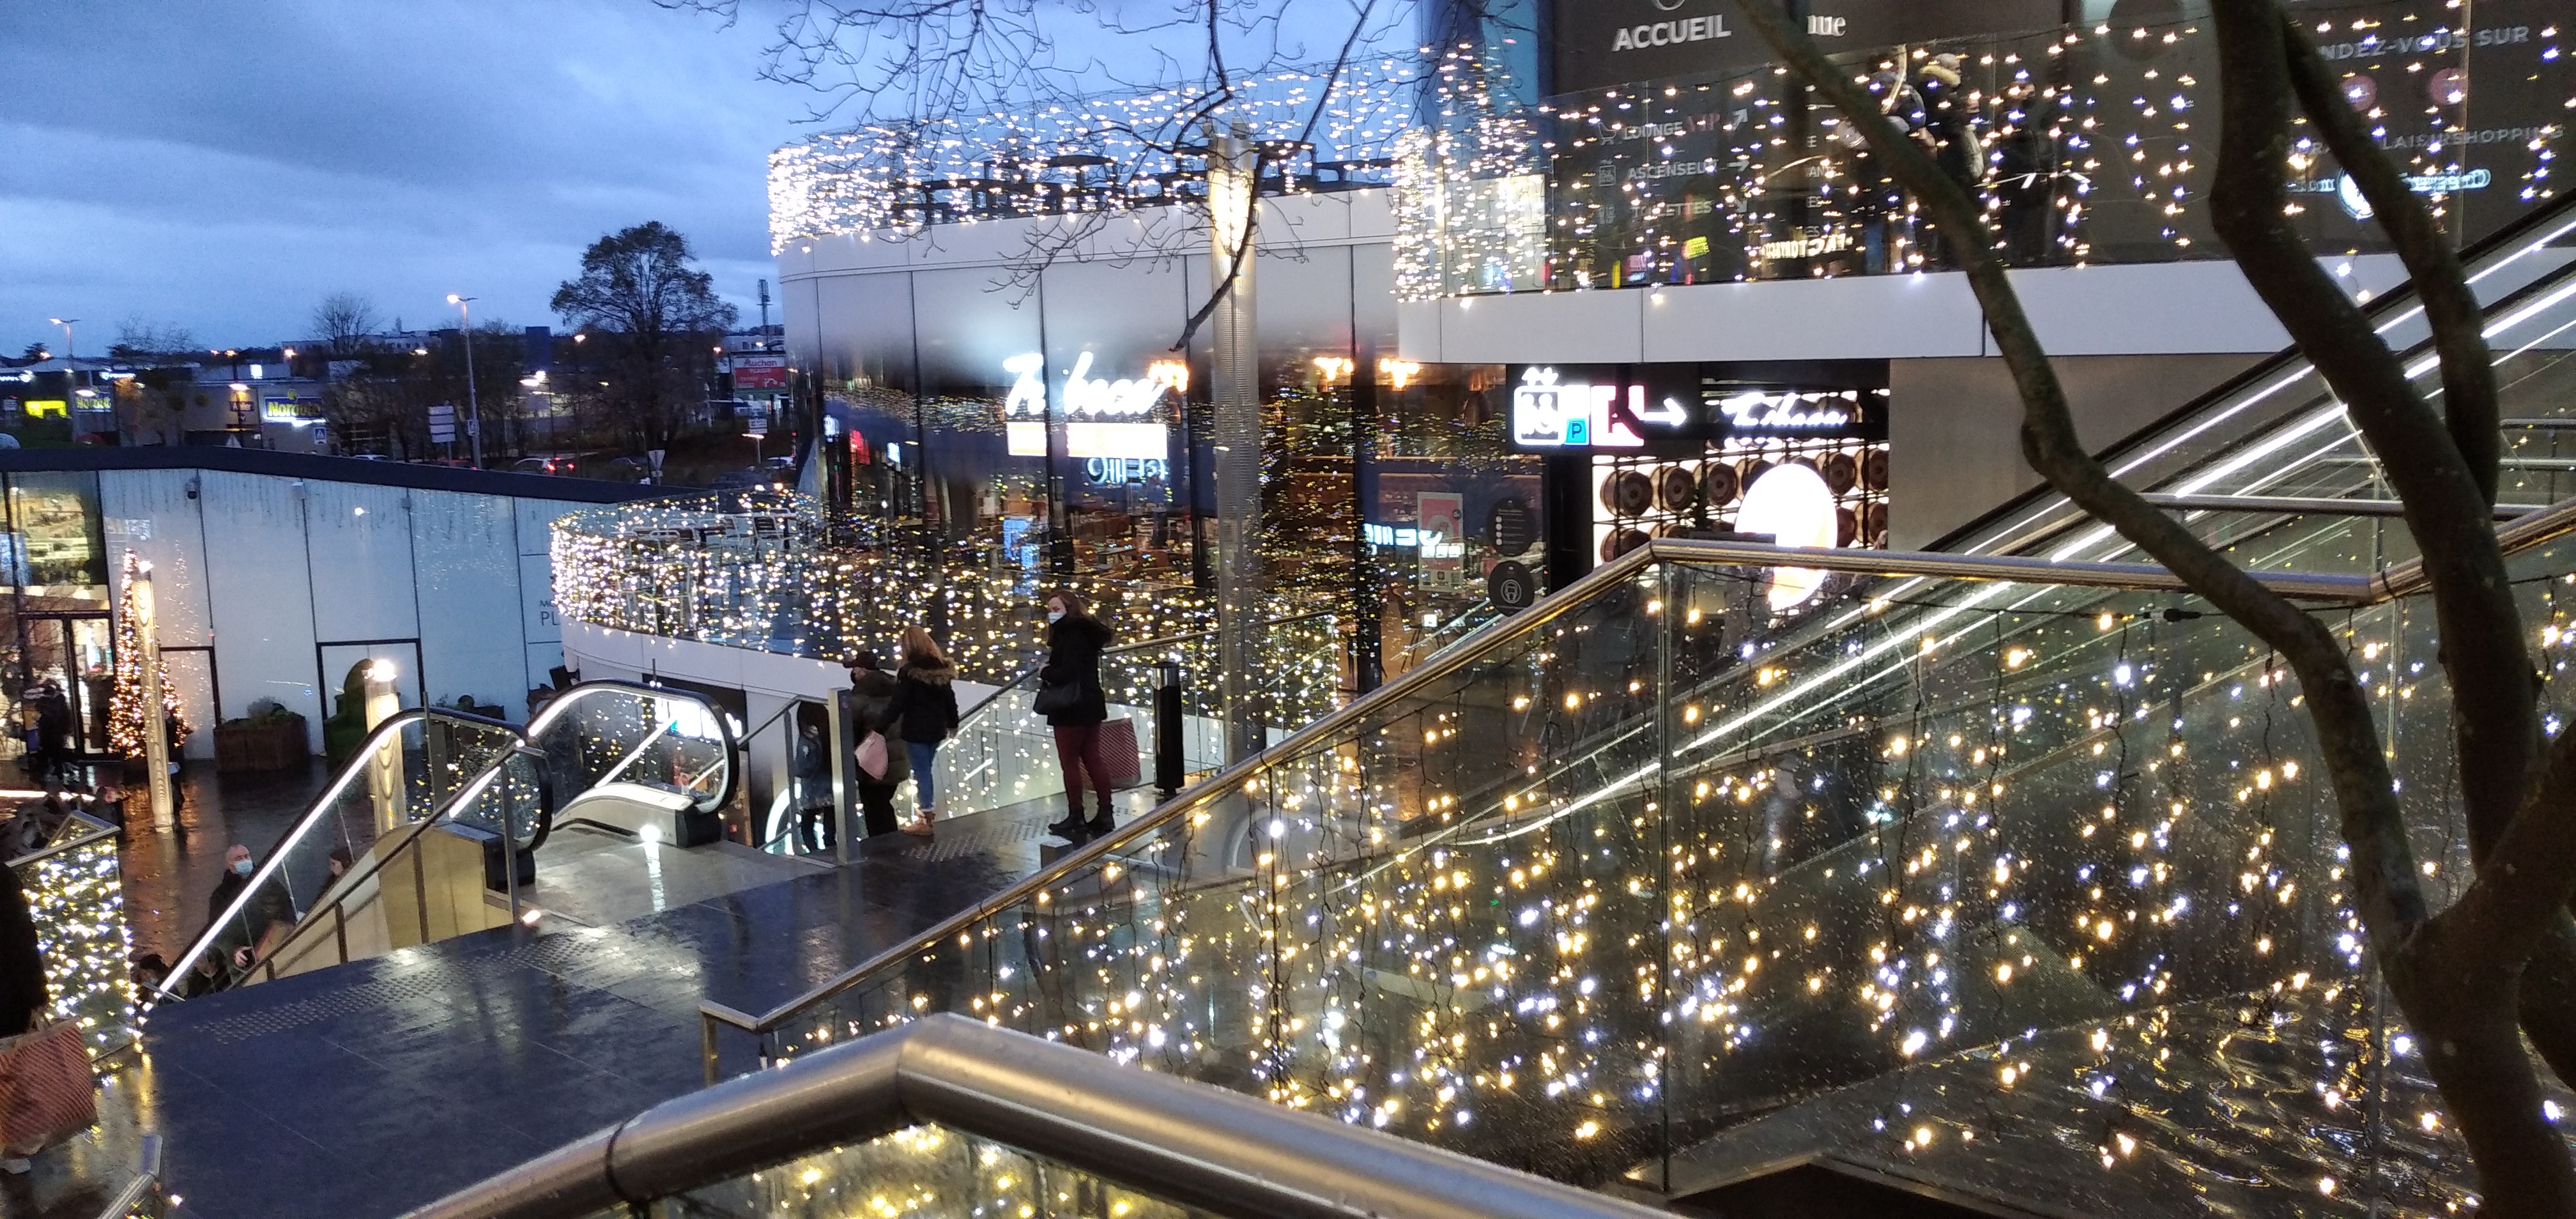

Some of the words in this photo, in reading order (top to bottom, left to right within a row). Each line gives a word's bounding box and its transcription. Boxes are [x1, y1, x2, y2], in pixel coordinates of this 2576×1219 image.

[1611, 14, 1732, 52] ACCUEIL
[2318, 27, 2467, 60] NDEZ-VOUS
[2474, 26, 2529, 47] SUR
[1623, 121, 1683, 140] LOUNGE
[743, 359, 778, 367] Auchan
[1572, 422, 1583, 439] P
